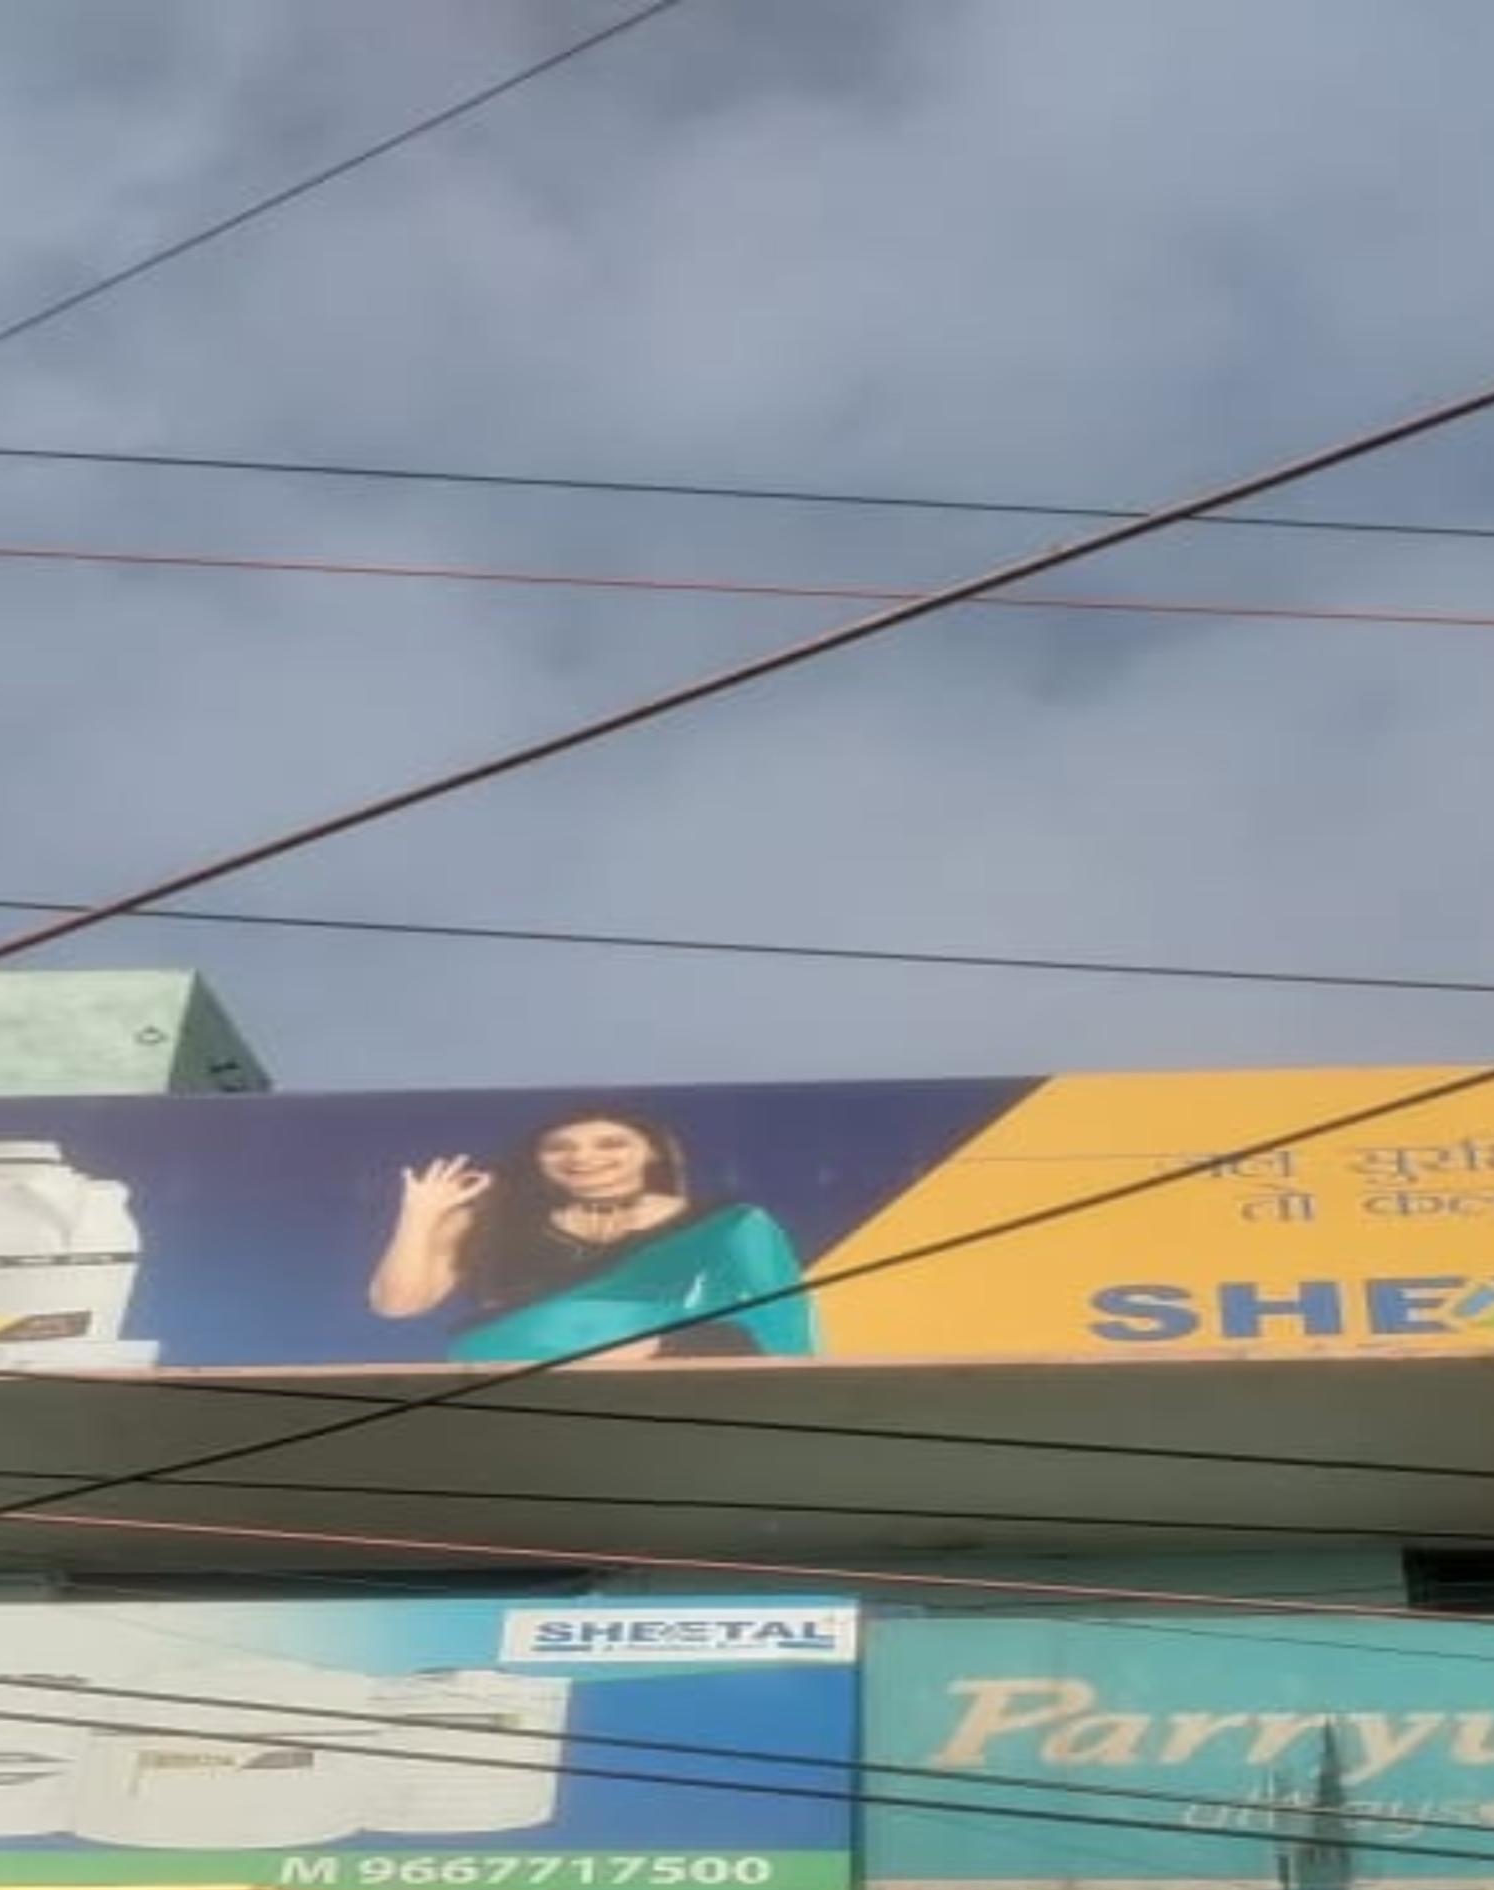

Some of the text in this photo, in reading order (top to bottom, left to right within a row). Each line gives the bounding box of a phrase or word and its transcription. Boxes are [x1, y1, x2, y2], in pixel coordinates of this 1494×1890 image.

[535, 1620, 837, 1644] SHEETAL
[279, 1855, 773, 1887] M 9667717500
